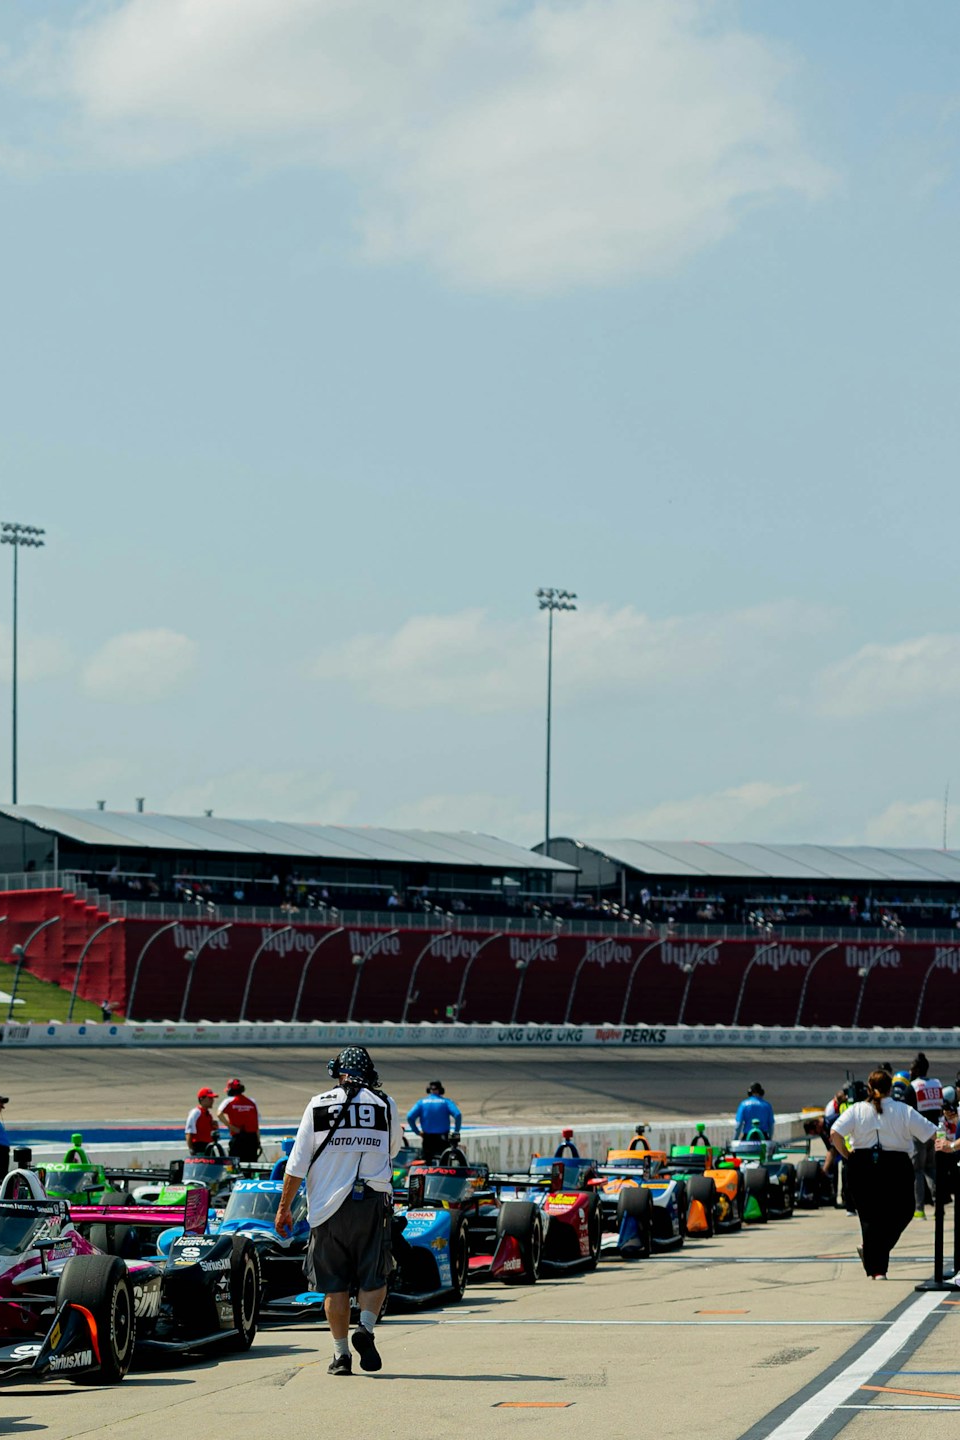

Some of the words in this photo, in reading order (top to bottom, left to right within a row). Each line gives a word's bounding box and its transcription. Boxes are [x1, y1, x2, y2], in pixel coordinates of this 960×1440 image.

[623, 1029, 666, 1042] PERKS
[328, 1104, 375, 1127] 319
[327, 1137, 381, 1147] HOTO/VIDEO
[200, 1258, 232, 1272] SiriusXM
[48, 1350, 92, 1371] SiriusXM
